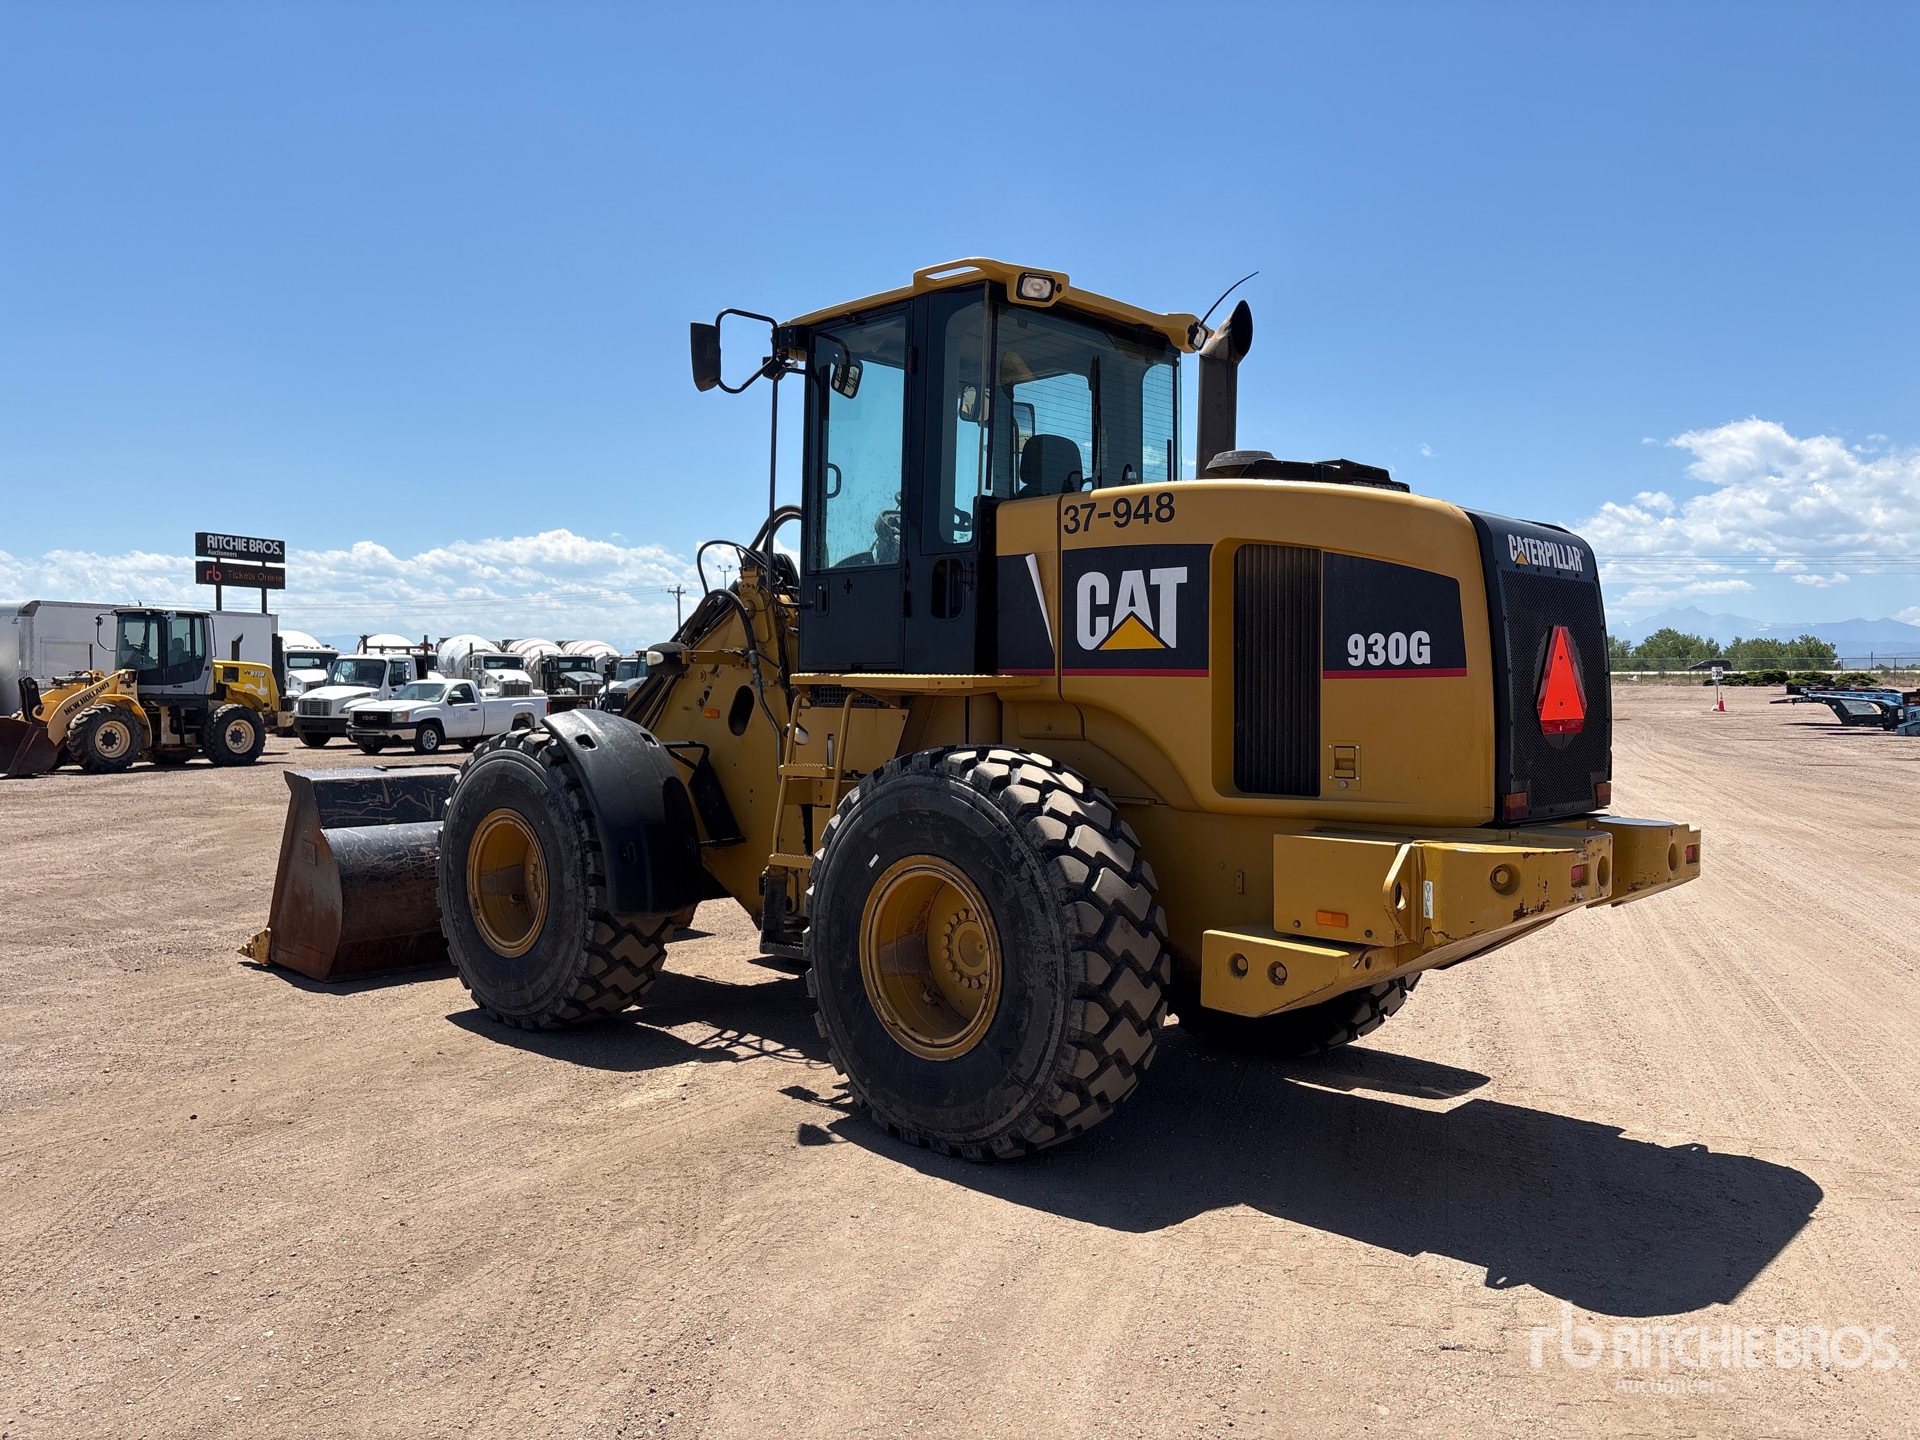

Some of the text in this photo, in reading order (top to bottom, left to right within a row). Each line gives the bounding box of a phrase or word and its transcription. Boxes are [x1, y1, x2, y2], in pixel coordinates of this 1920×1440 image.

[1063, 492, 1175, 534] 37-948
[207, 534, 282, 555] RITCHIE BROS.
[207, 548, 238, 558] Auctioneers
[1507, 533, 1583, 572] CATERPILLAR
[205, 564, 222, 582] rb
[227, 569, 283, 583] Tickets Online
[1076, 566, 1188, 651] CAT
[1347, 630, 1431, 667] 930G
[64, 682, 110, 716] NEW HOLLAND
